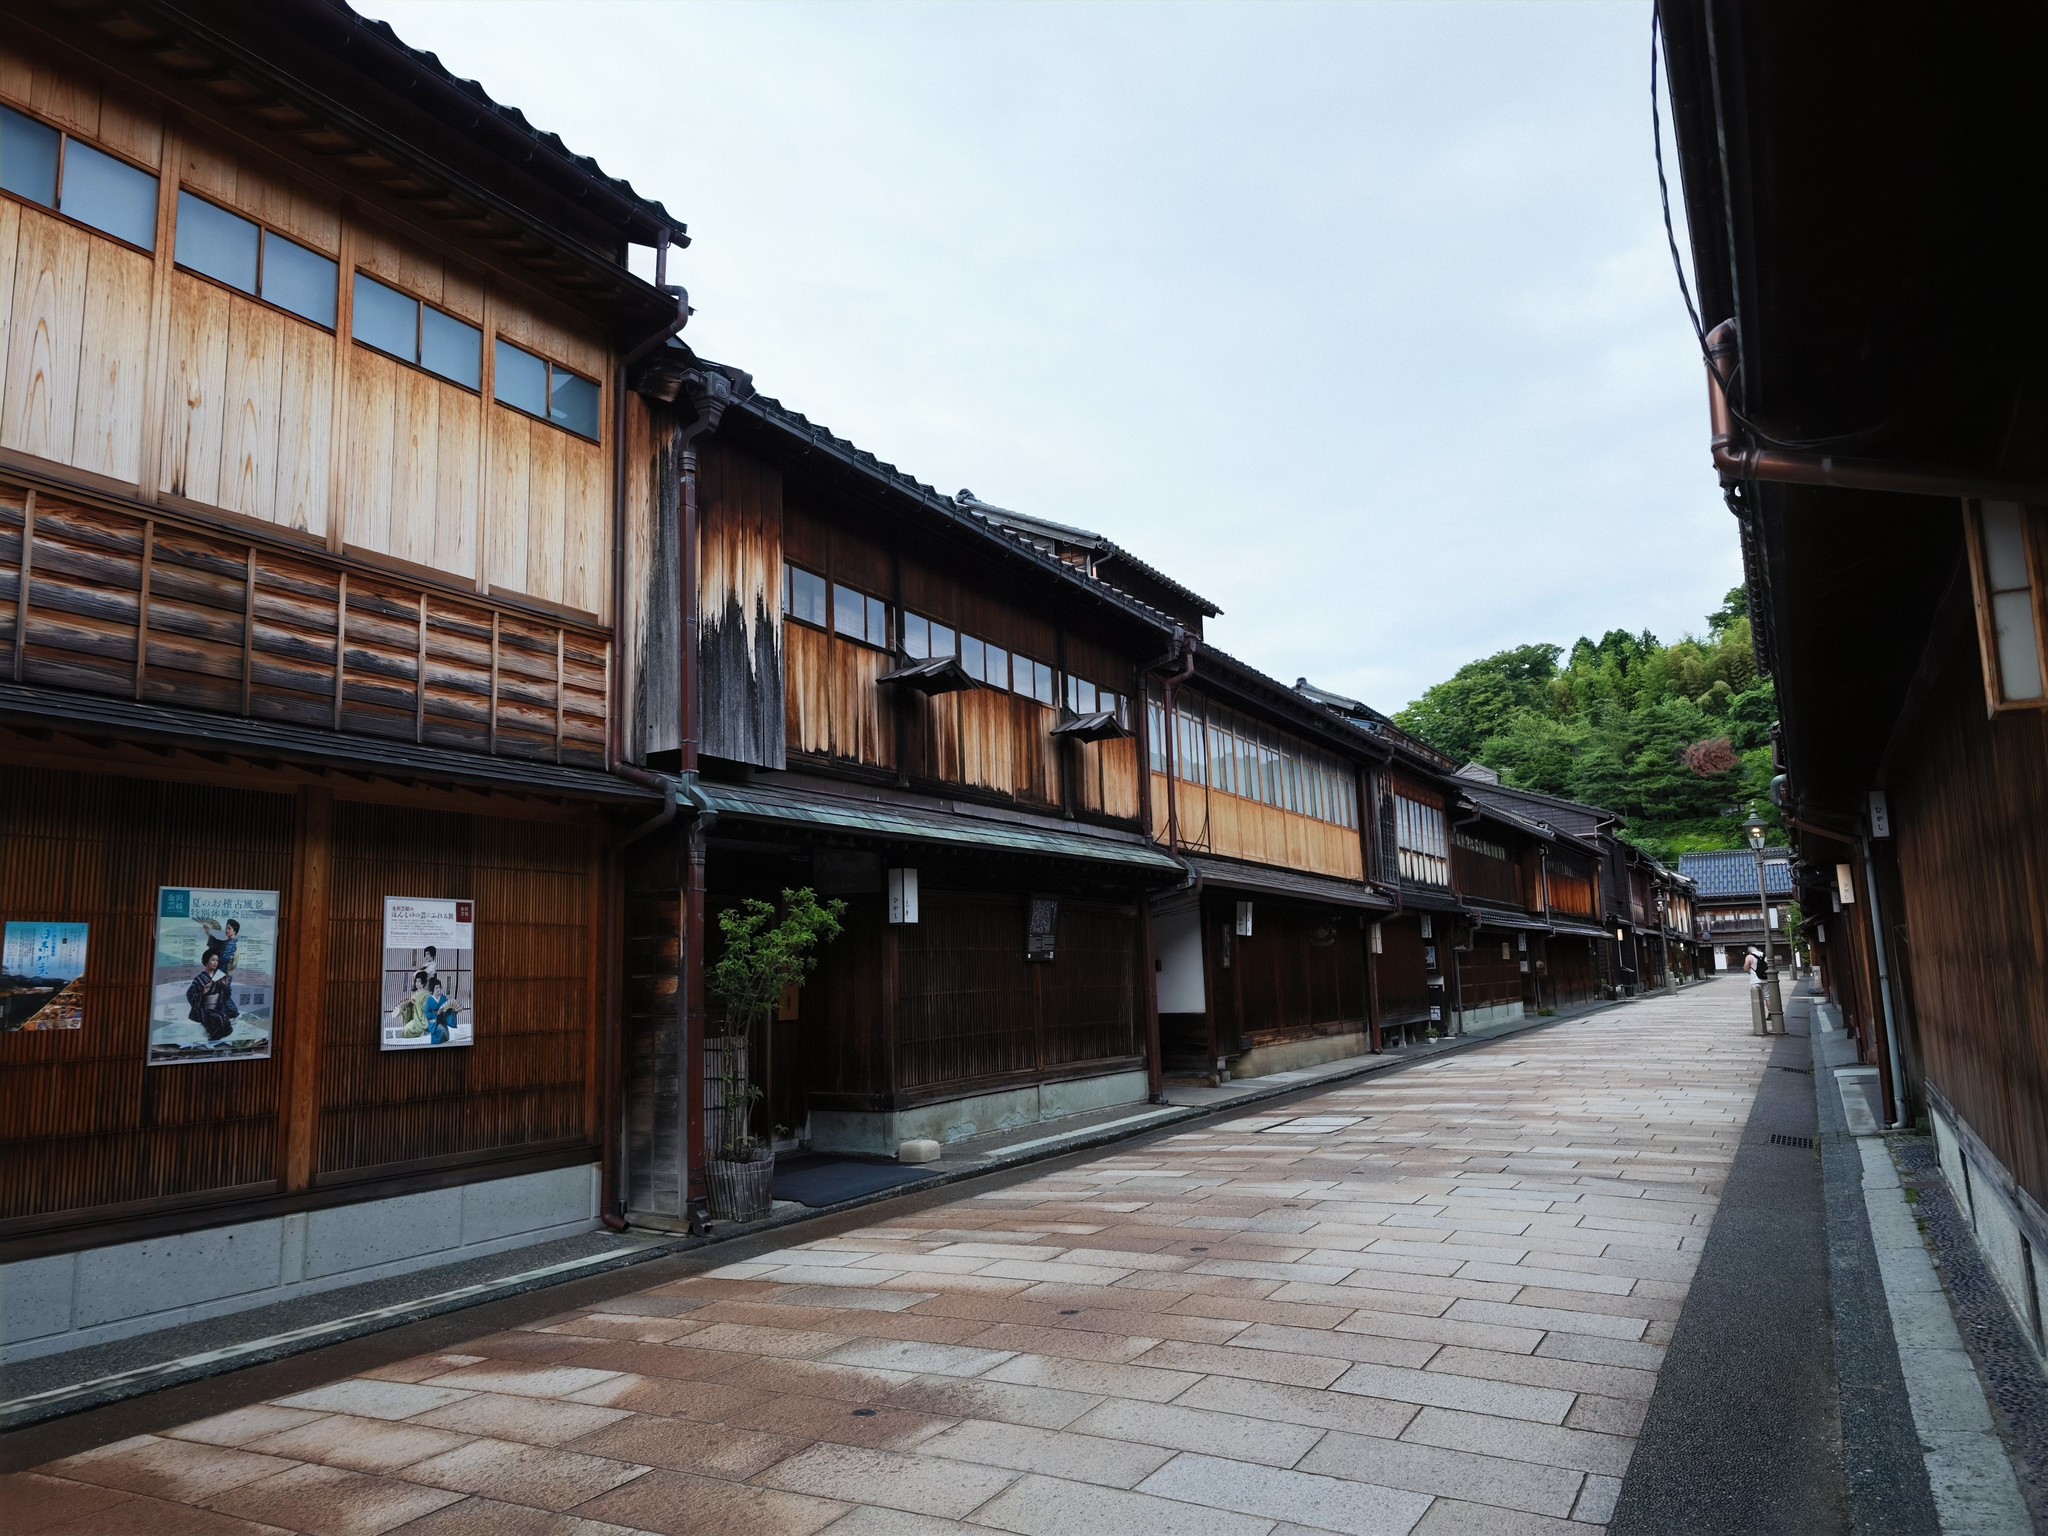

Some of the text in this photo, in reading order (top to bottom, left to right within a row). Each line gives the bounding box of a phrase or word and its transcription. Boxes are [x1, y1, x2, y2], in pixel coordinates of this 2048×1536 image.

[1875, 807, 1883, 831] ひがし
[192, 897, 265, 910] 夏のお稽古風景
[191, 907, 240, 919] 特別体験会
[391, 910, 454, 920] ほんものの芸にふれる旅
